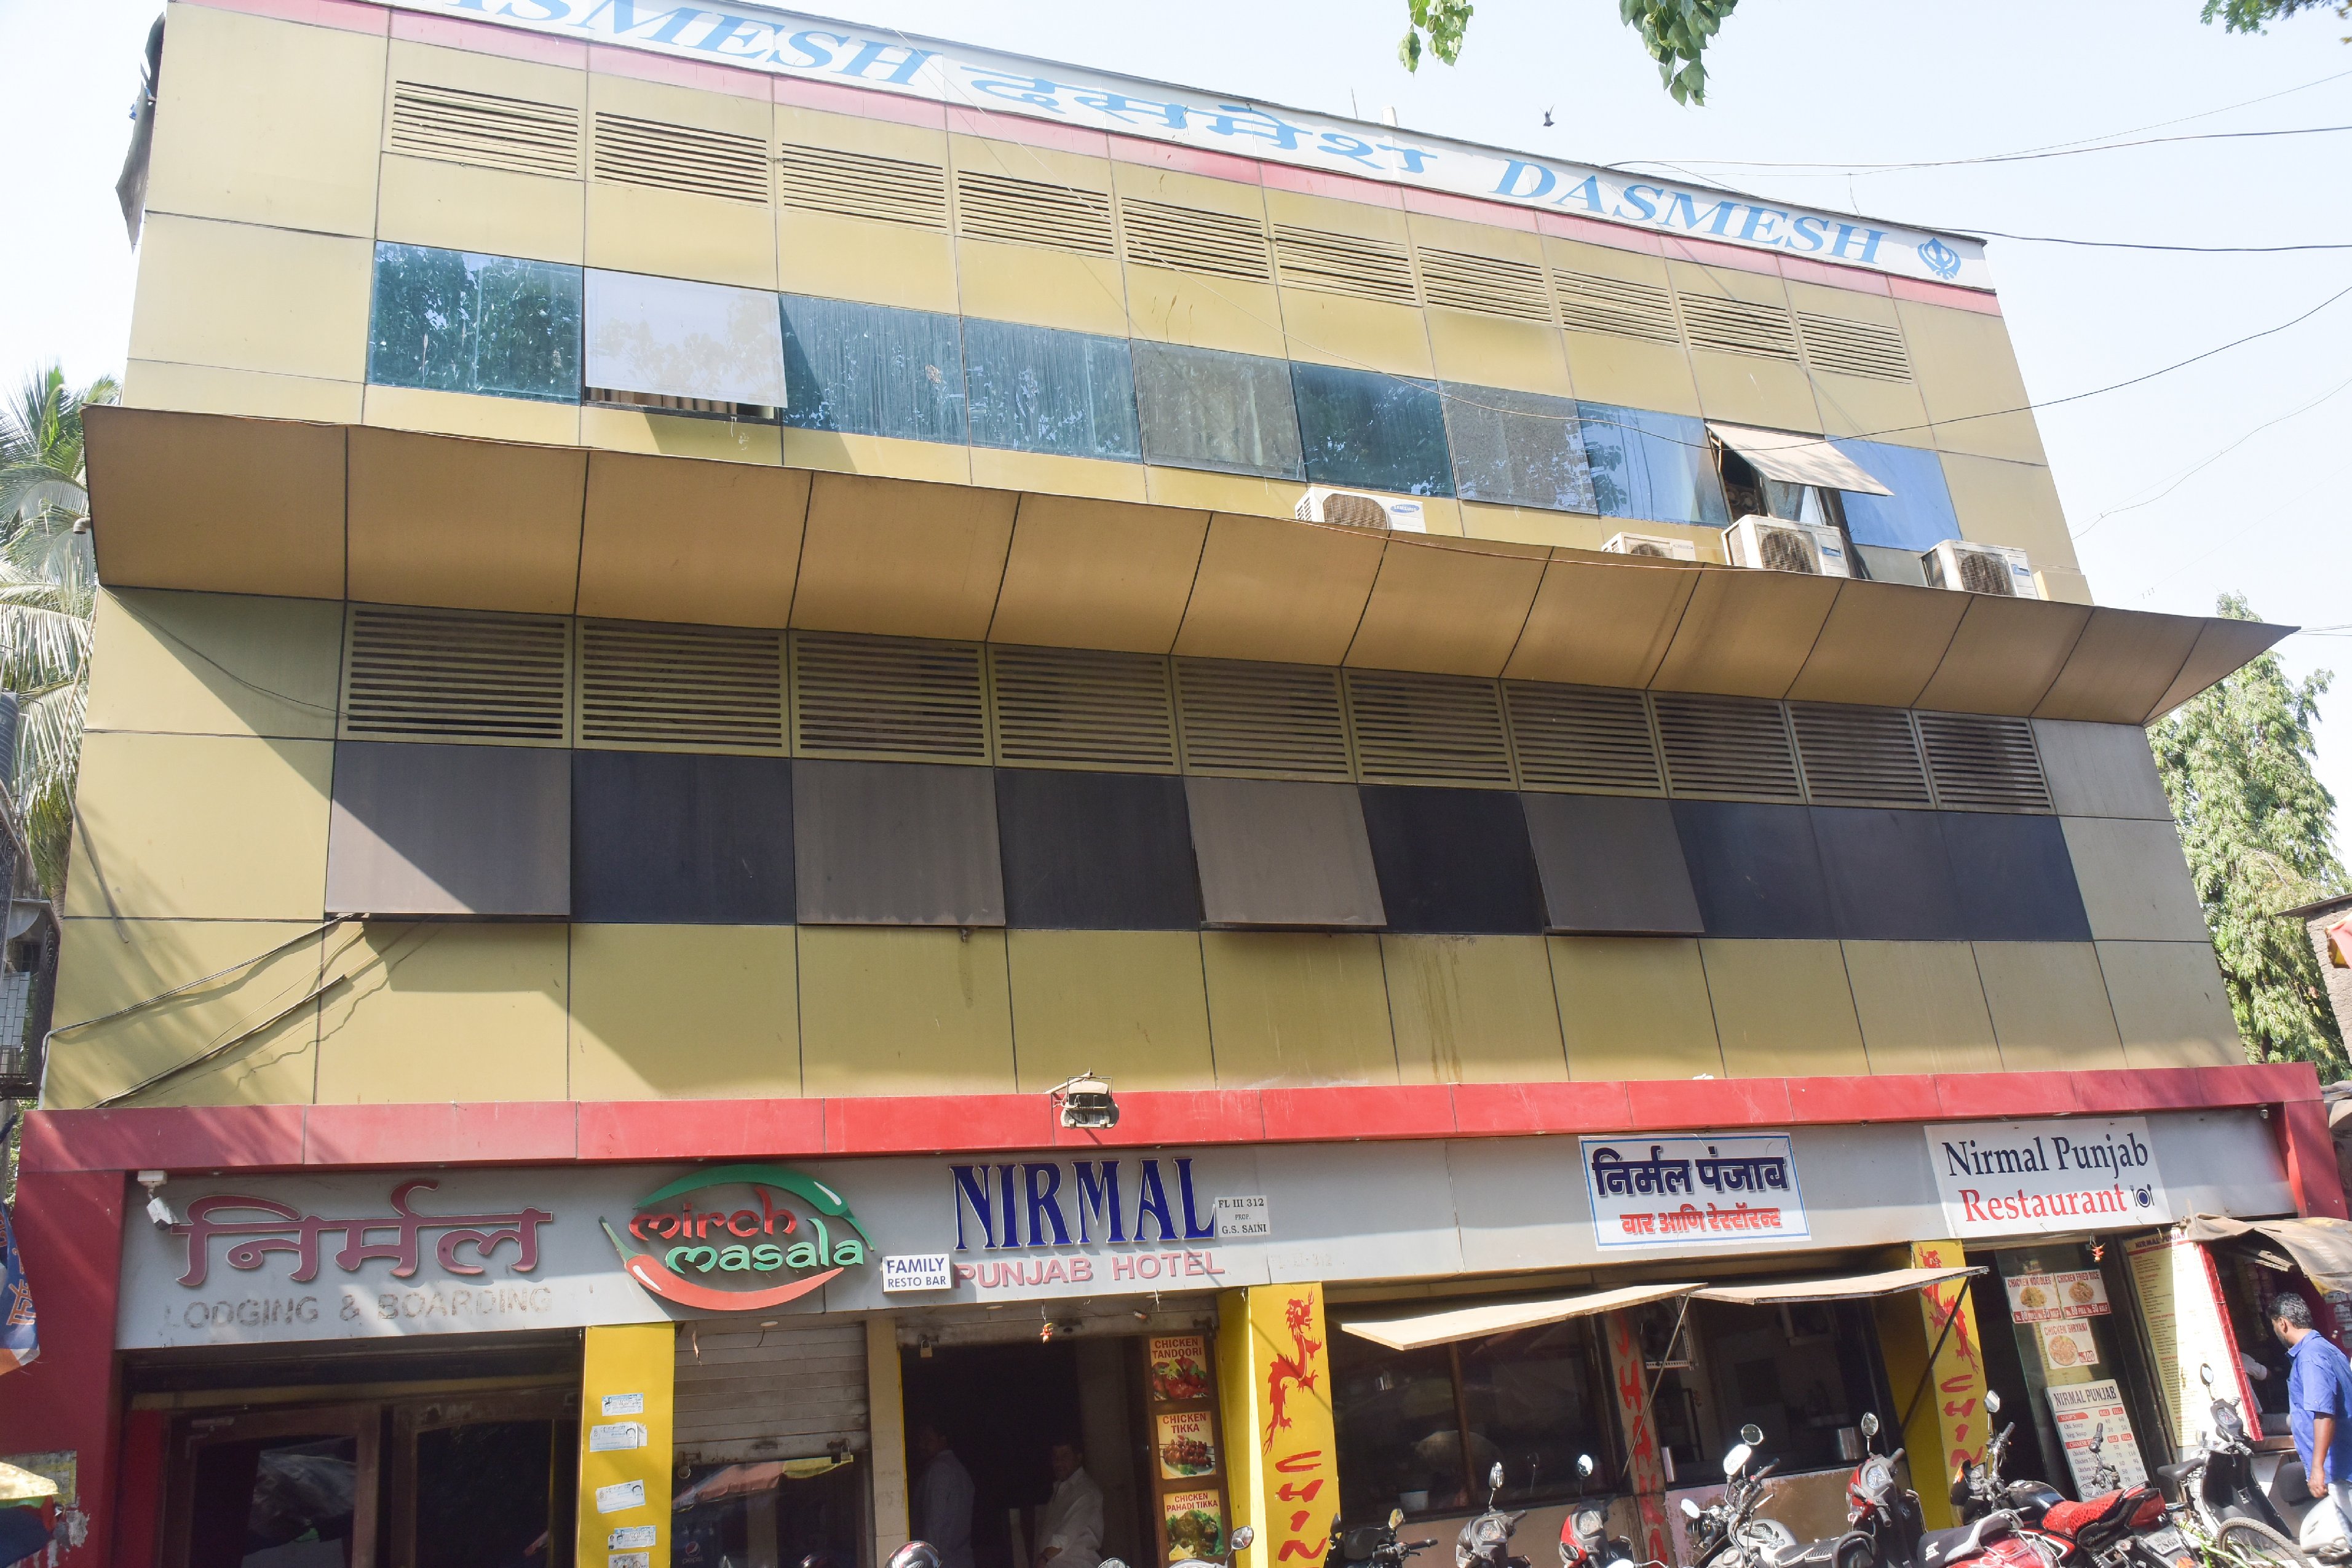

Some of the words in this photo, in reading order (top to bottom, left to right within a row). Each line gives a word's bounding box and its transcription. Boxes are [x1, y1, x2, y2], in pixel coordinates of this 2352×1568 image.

[1488, 159, 1888, 264] DASMESH
[1942, 1136, 2049, 1177] Nirmal
[2051, 1133, 2148, 1179] Punjab
[1591, 1145, 1691, 1197] निर्मल
[1695, 1146, 1790, 1193] पंजाब
[949, 1157, 1216, 1251] NIRMAL
[1218, 1200, 1230, 1208] FL
[1232, 1199, 1244, 1208] III
[1246, 1198, 1264, 1207] 312
[1958, 1183, 2127, 1222] Restaurant
[629, 1186, 797, 1241] mirch
[1620, 1213, 1655, 1234] बार
[1658, 1203, 1706, 1233] आणि
[170, 1178, 552, 1287] निर्मल
[1222, 1225, 1240, 1234] G.S.
[1242, 1224, 1267, 1233] SAINI
[666, 1217, 863, 1273] masala
[887, 1257, 944, 1274] FAMILY
[953, 1256, 1092, 1289] PUNJAB
[1112, 1251, 1225, 1281] HOTEL
[888, 1277, 922, 1288] RESTO
[926, 1276, 946, 1286] BAR
[2057, 1274, 2076, 1284] CHICKEN
[339, 1294, 360, 1321] &
[378, 1287, 553, 1321] BOARDING
[2092, 1304, 2099, 1313] 50
[2044, 1324, 2067, 1336] CHICKEN
[2068, 1323, 2088, 1333] BIRYANI
[1155, 1338, 1198, 1348] CHICKEN
[1152, 1348, 1202, 1358] TANDOORI
[2053, 1390, 2086, 1406] NIRMAL
[2085, 1386, 2116, 1402] PUNJAB
[1163, 1413, 1206, 1424] CHICKEN
[1171, 1423, 1200, 1433] TIKKA
[1166, 1502, 1195, 1511] PAHADI
[1196, 1500, 1218, 1509] TIKKA
[1174, 1492, 1208, 1502] CHICKEN
